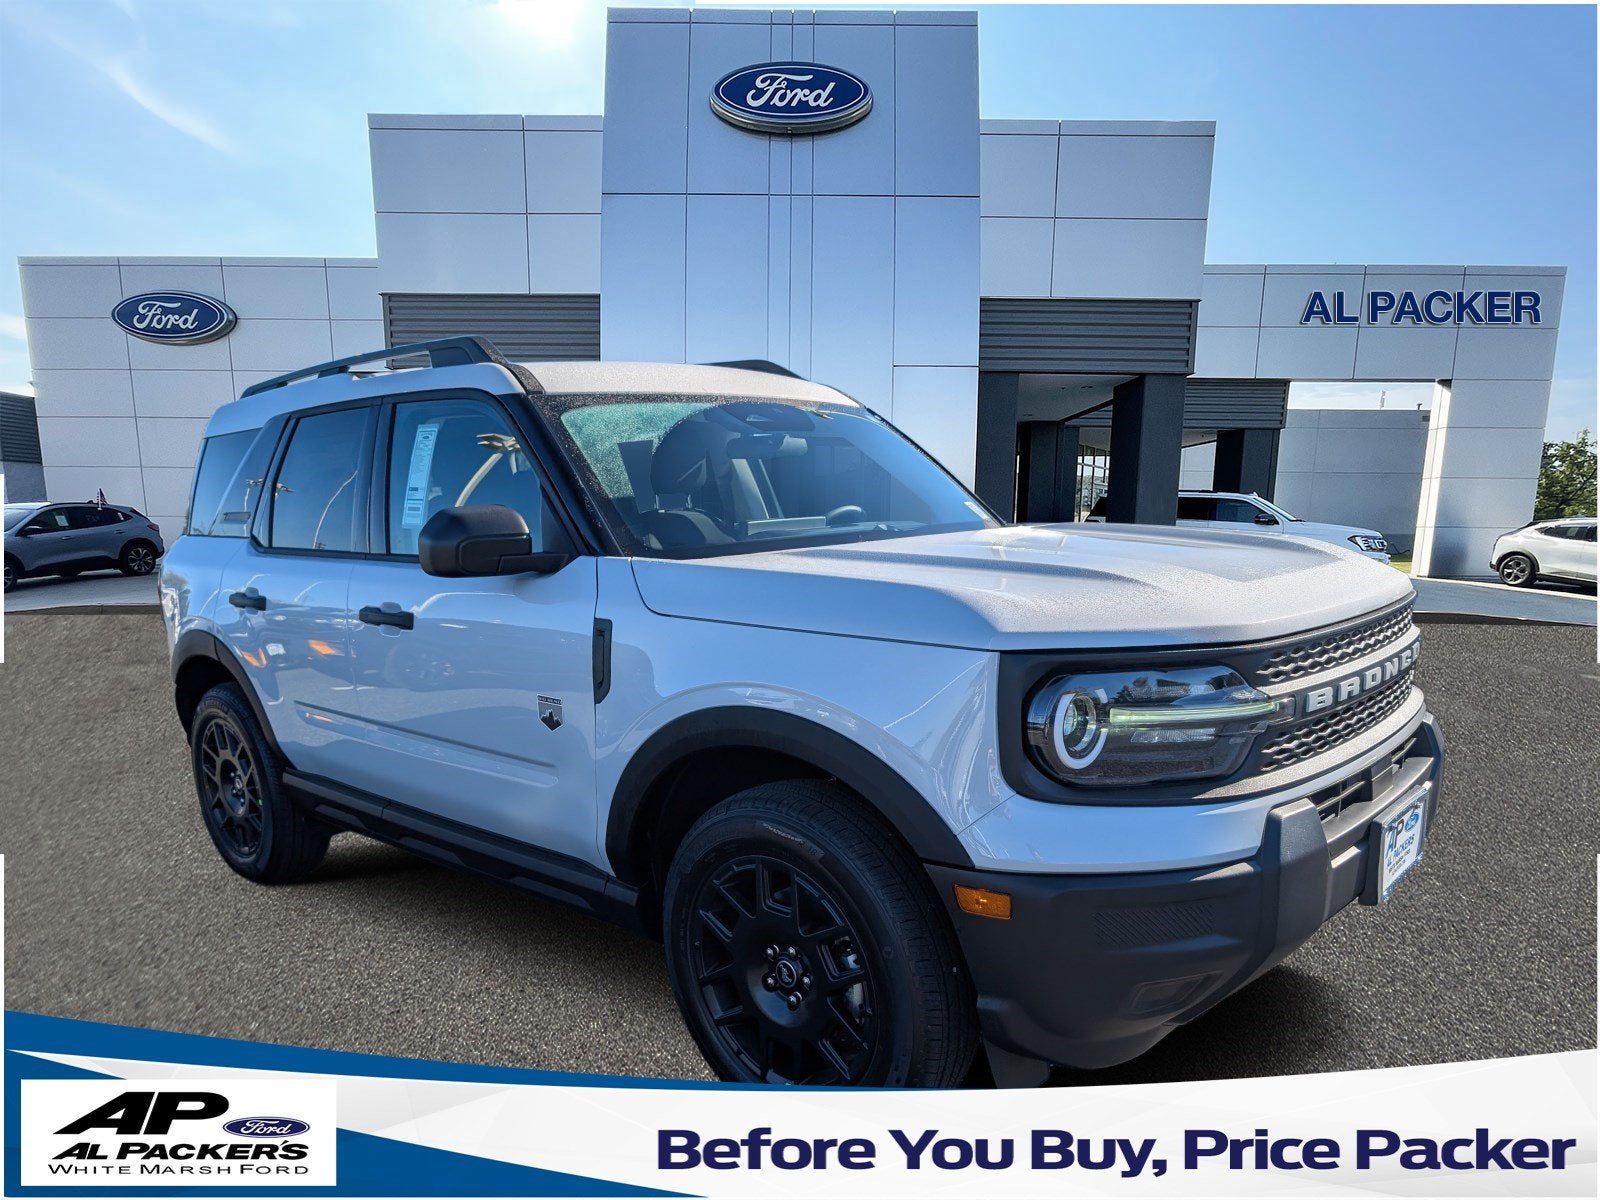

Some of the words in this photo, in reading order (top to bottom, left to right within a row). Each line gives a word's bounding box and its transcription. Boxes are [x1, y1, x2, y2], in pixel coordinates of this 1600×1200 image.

[746, 73, 836, 108] Ford
[133, 301, 199, 329] Ford
[1301, 290, 1359, 324] AL
[1368, 290, 1542, 324] PACKER
[1305, 641, 1421, 713] BRONCO
